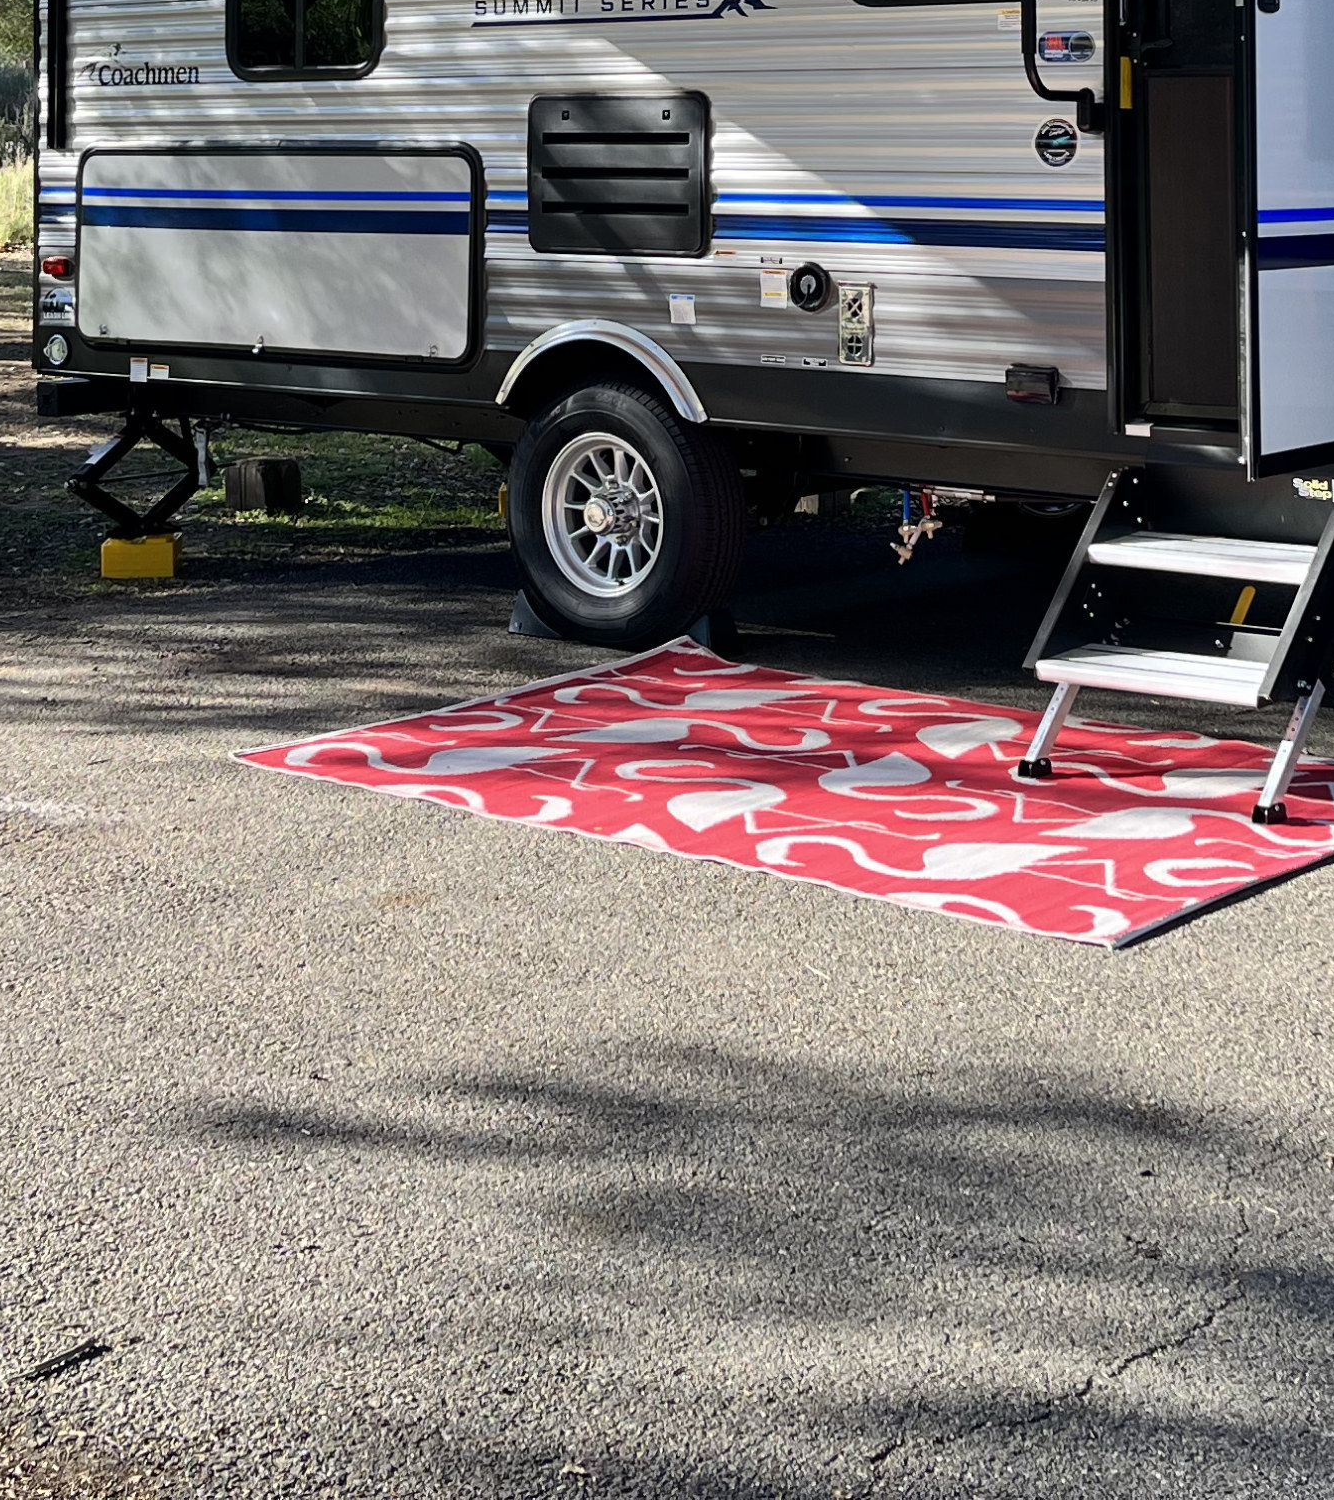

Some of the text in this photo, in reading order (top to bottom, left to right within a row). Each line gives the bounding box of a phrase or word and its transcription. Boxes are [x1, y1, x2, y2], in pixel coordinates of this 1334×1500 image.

[98, 61, 200, 86] Coachmen
[1292, 477, 1329, 490] Solid
[1298, 486, 1333, 500] Step
